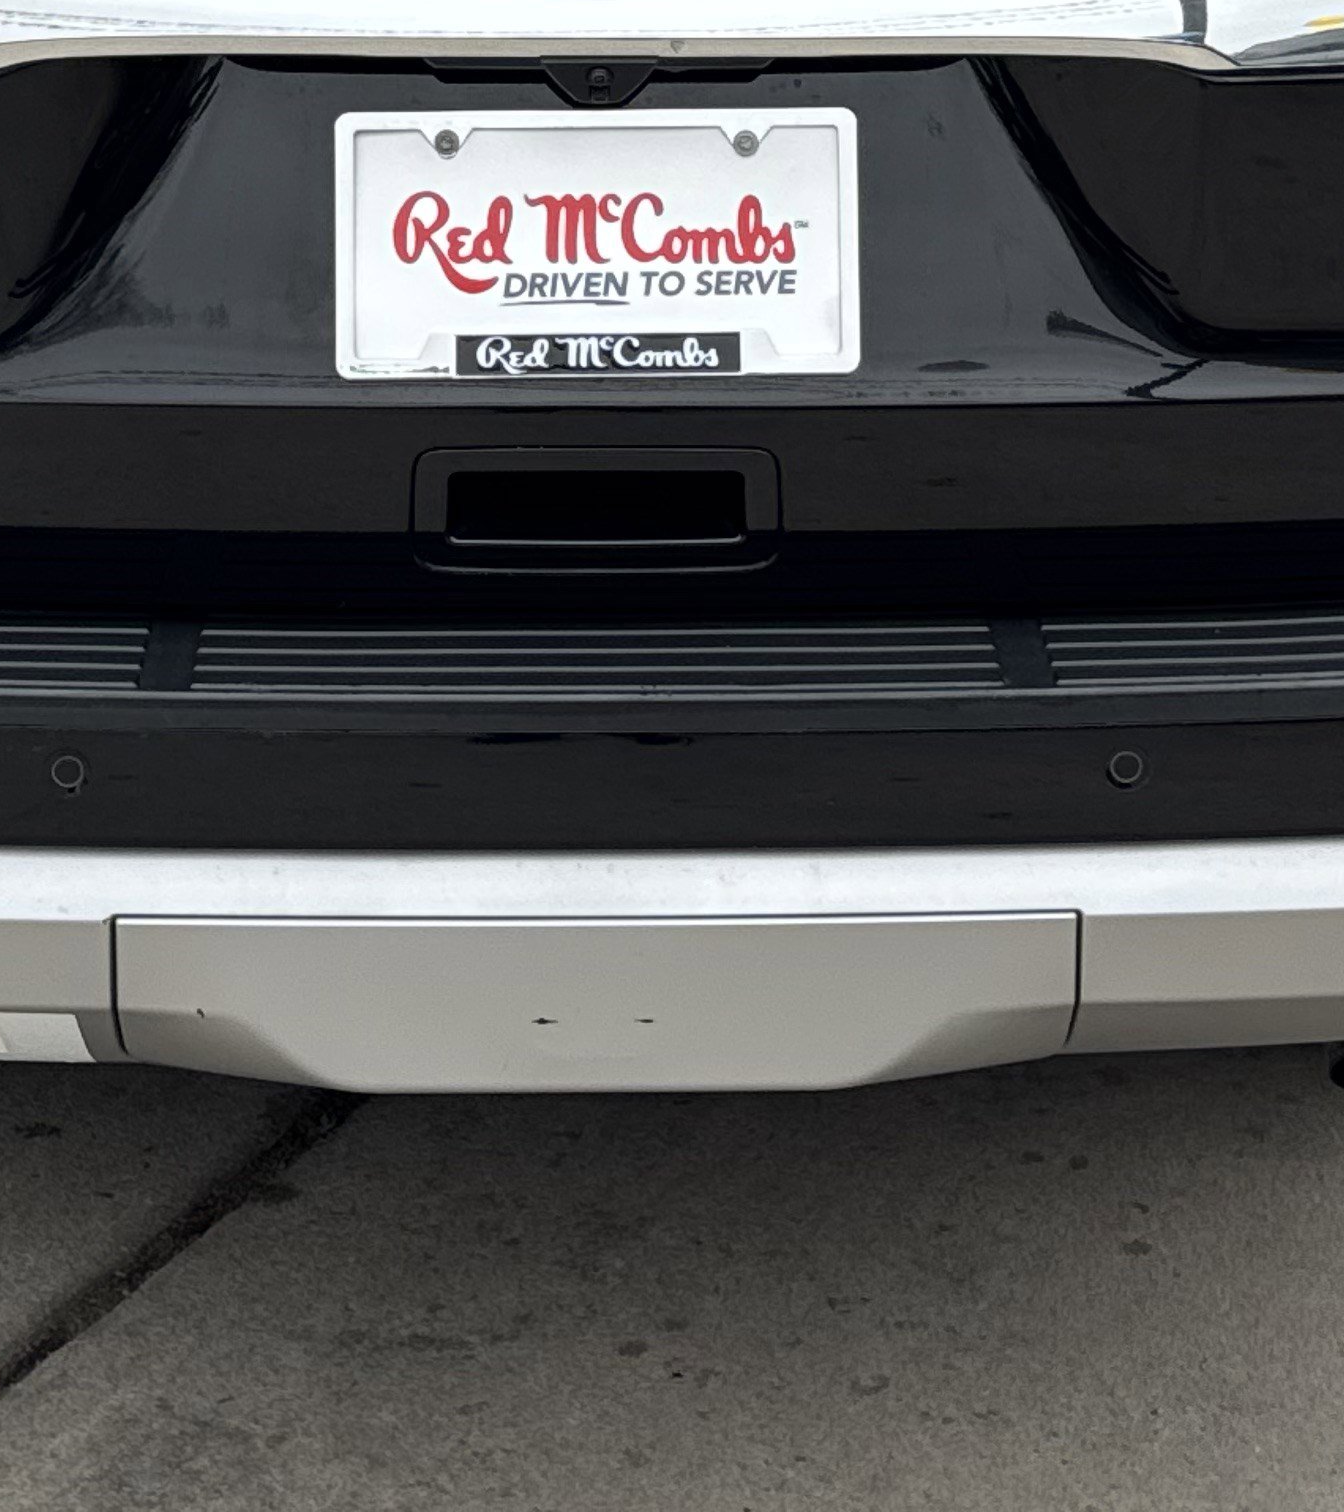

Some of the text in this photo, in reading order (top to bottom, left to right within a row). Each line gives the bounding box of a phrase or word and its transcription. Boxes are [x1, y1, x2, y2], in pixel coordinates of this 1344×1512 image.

[393, 190, 796, 295] Red McCombs
[503, 269, 797, 298] DRIVEN TO SERVE
[476, 336, 720, 375] Red McCombs
